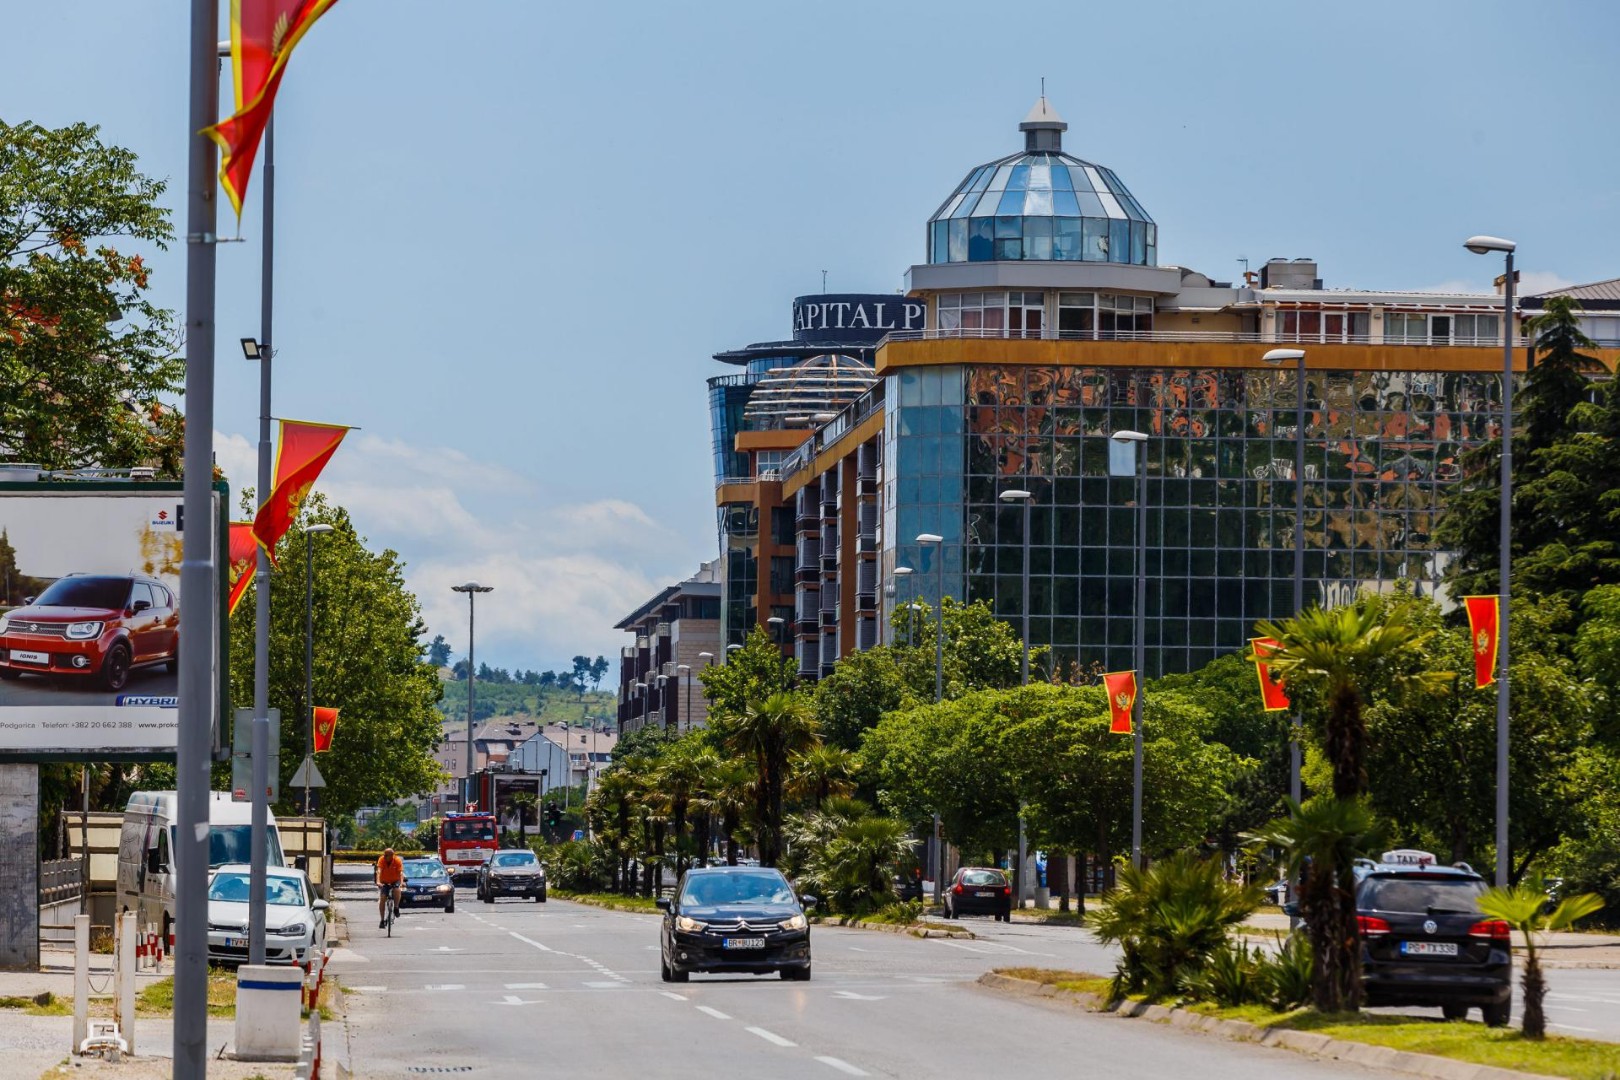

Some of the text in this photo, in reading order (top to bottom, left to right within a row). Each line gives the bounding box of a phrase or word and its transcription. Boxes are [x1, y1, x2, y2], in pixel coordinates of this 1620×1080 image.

[795, 303, 895, 330] APITAL
[128, 698, 176, 706] HYBRI
[0, 721, 36, 729] Podgorica
[72, 721, 89, 729] +382
[91, 721, 101, 729] 20
[102, 721, 117, 729] 662
[119, 721, 133, 729] 388
